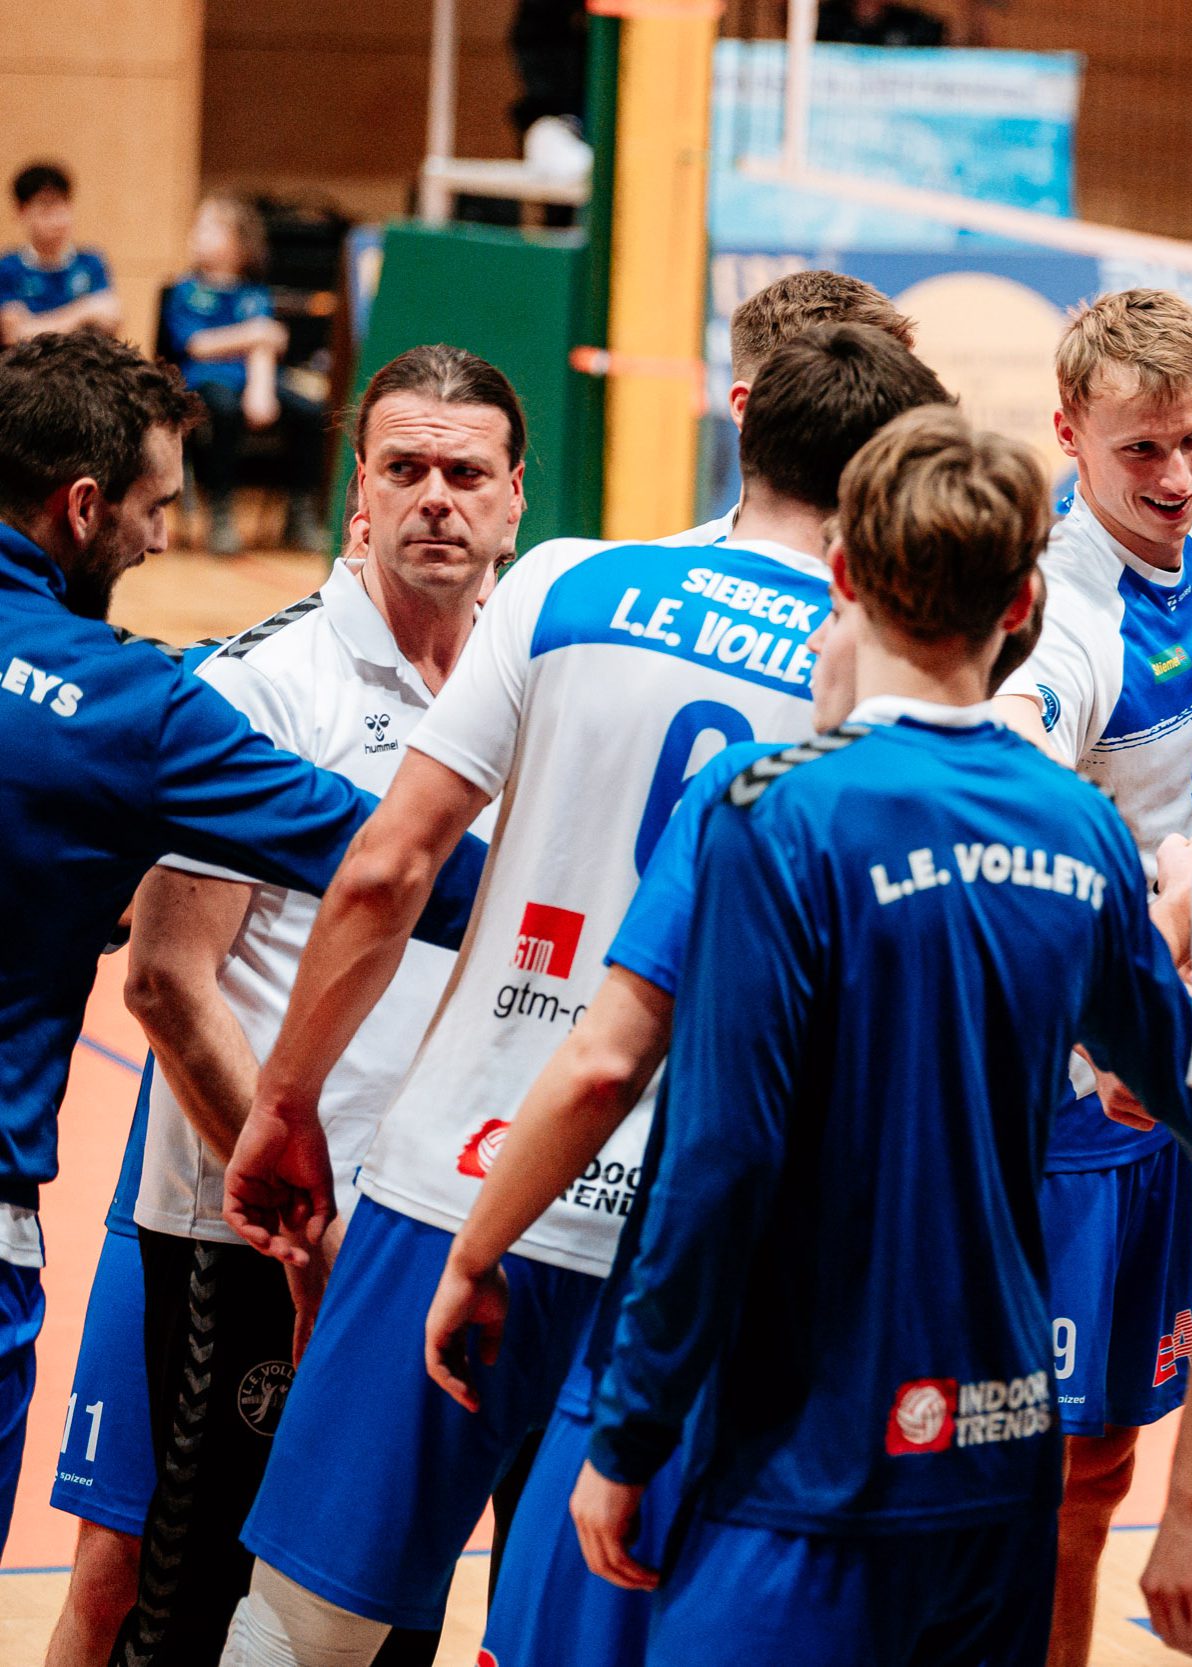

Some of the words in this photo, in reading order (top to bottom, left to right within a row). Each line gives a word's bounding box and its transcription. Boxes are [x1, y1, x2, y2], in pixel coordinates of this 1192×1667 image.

[681, 567, 819, 632] SIEBECK
[609, 587, 684, 647] L.E.
[693, 610, 816, 689] VOLLE
[364, 738, 399, 755] hummel
[869, 847, 952, 906] L.E.
[953, 842, 1107, 912] VOLLEYS
[1052, 1317, 1077, 1380] 9
[261, 1364, 295, 1380] VOLL
[959, 1371, 1049, 1416] INDOOR
[956, 1402, 1051, 1448] TRENDS
[60, 1471, 94, 1487] spized
